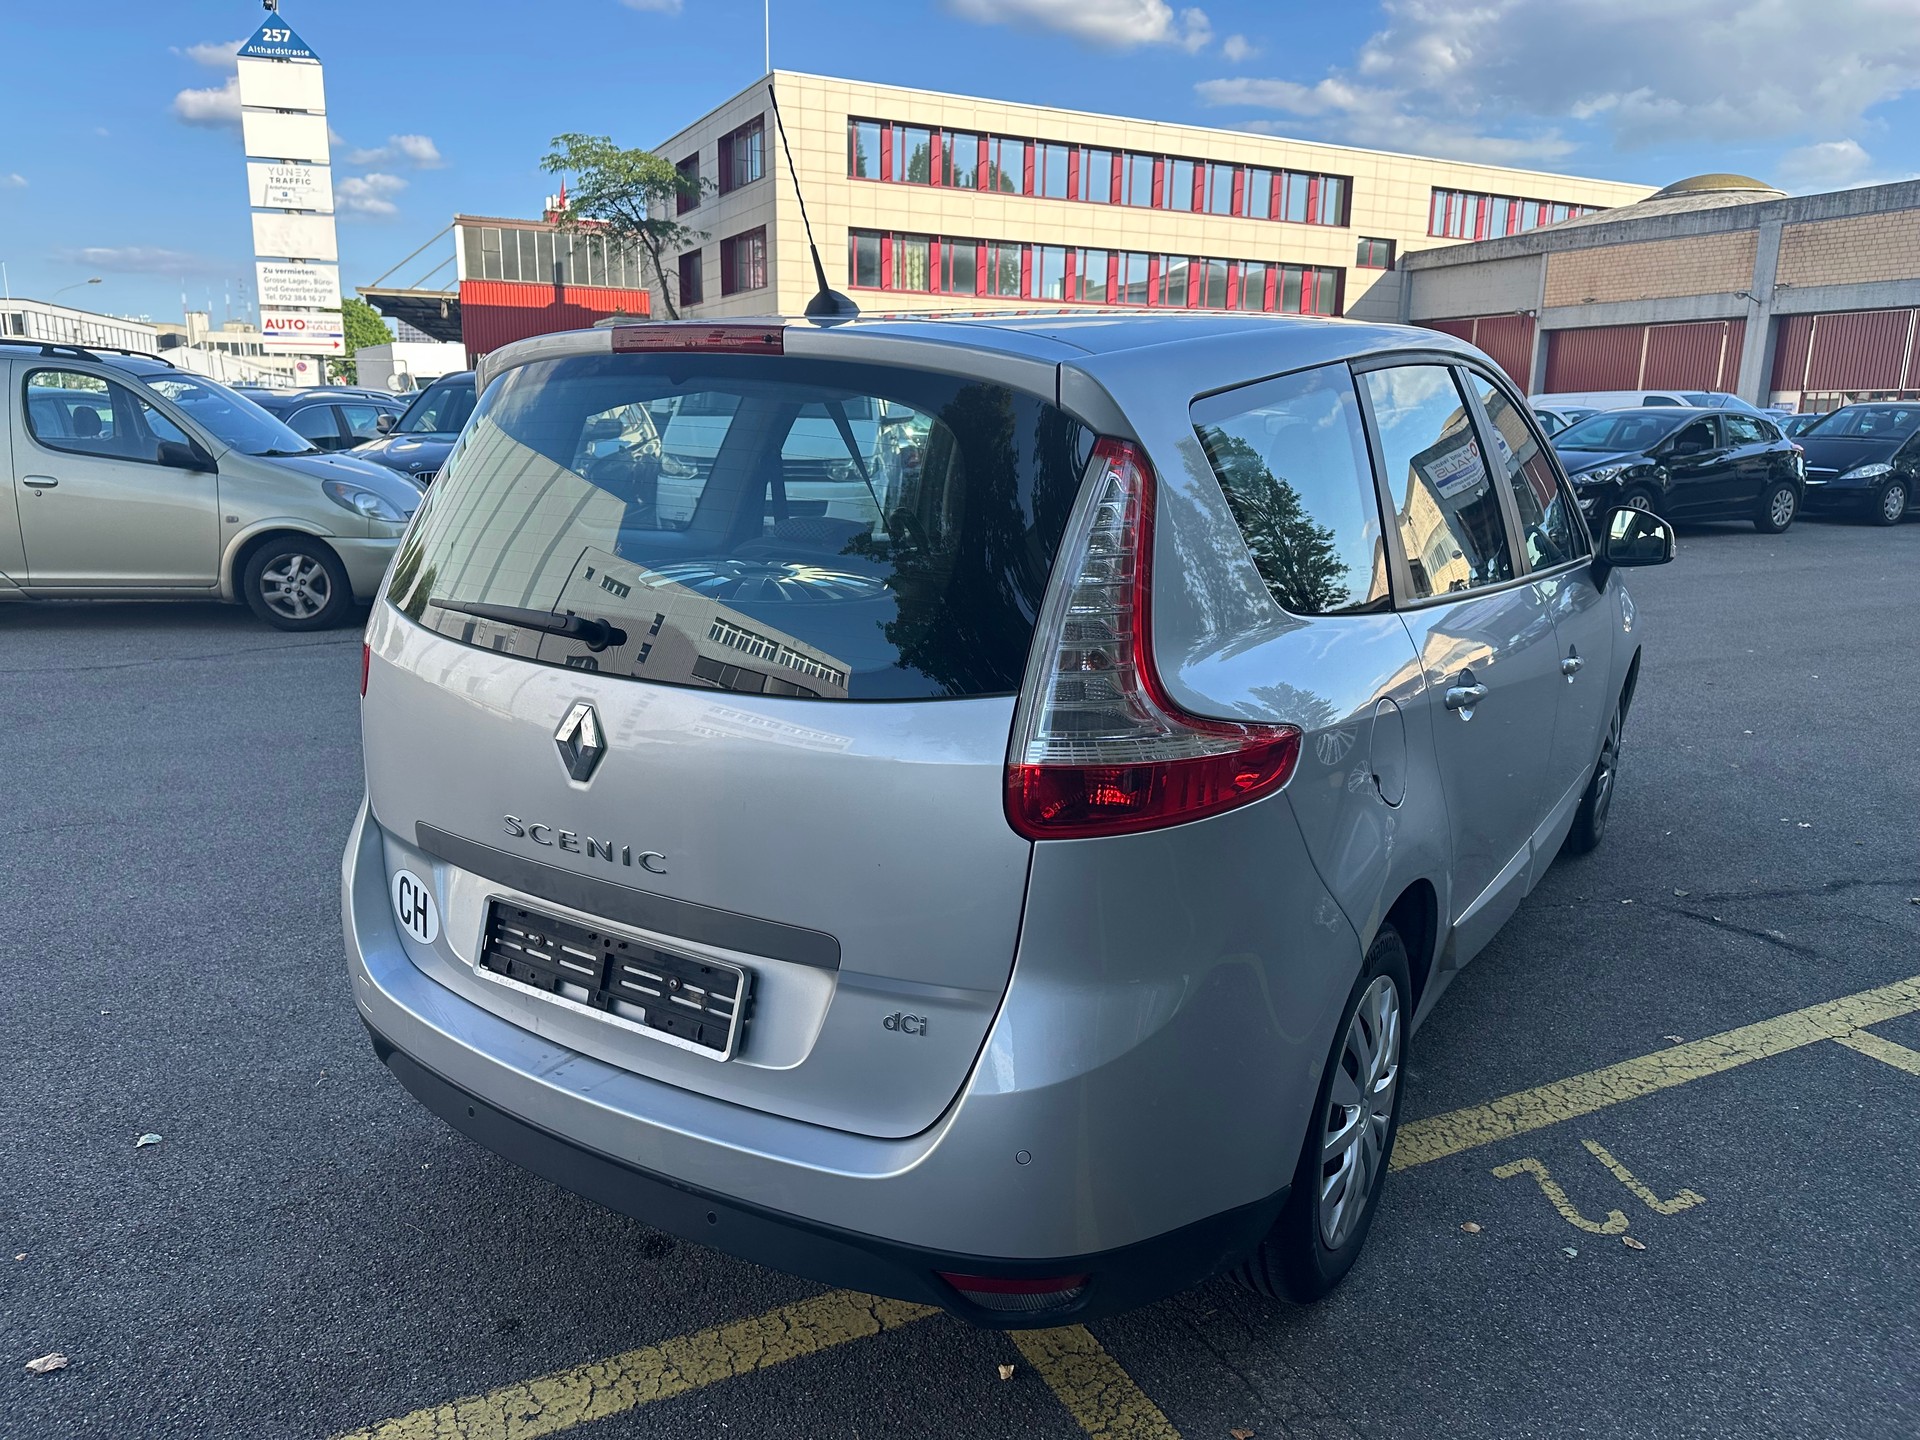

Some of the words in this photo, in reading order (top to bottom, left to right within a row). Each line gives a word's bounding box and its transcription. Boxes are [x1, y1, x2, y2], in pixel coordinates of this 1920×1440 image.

[262, 28, 290, 42] 257
[247, 45, 310, 57] Althardstrasse
[267, 167, 311, 177] YUNEX
[269, 177, 312, 185] TRAFFIC
[275, 268, 317, 276] vermieten:
[263, 276, 287, 284] Grosse
[279, 286, 333, 294] Gewerberäume
[265, 319, 306, 330] AUTO
[503, 814, 667, 874] SCENIC
[399, 876, 428, 939] CH
[882, 1011, 928, 1037] dCi
